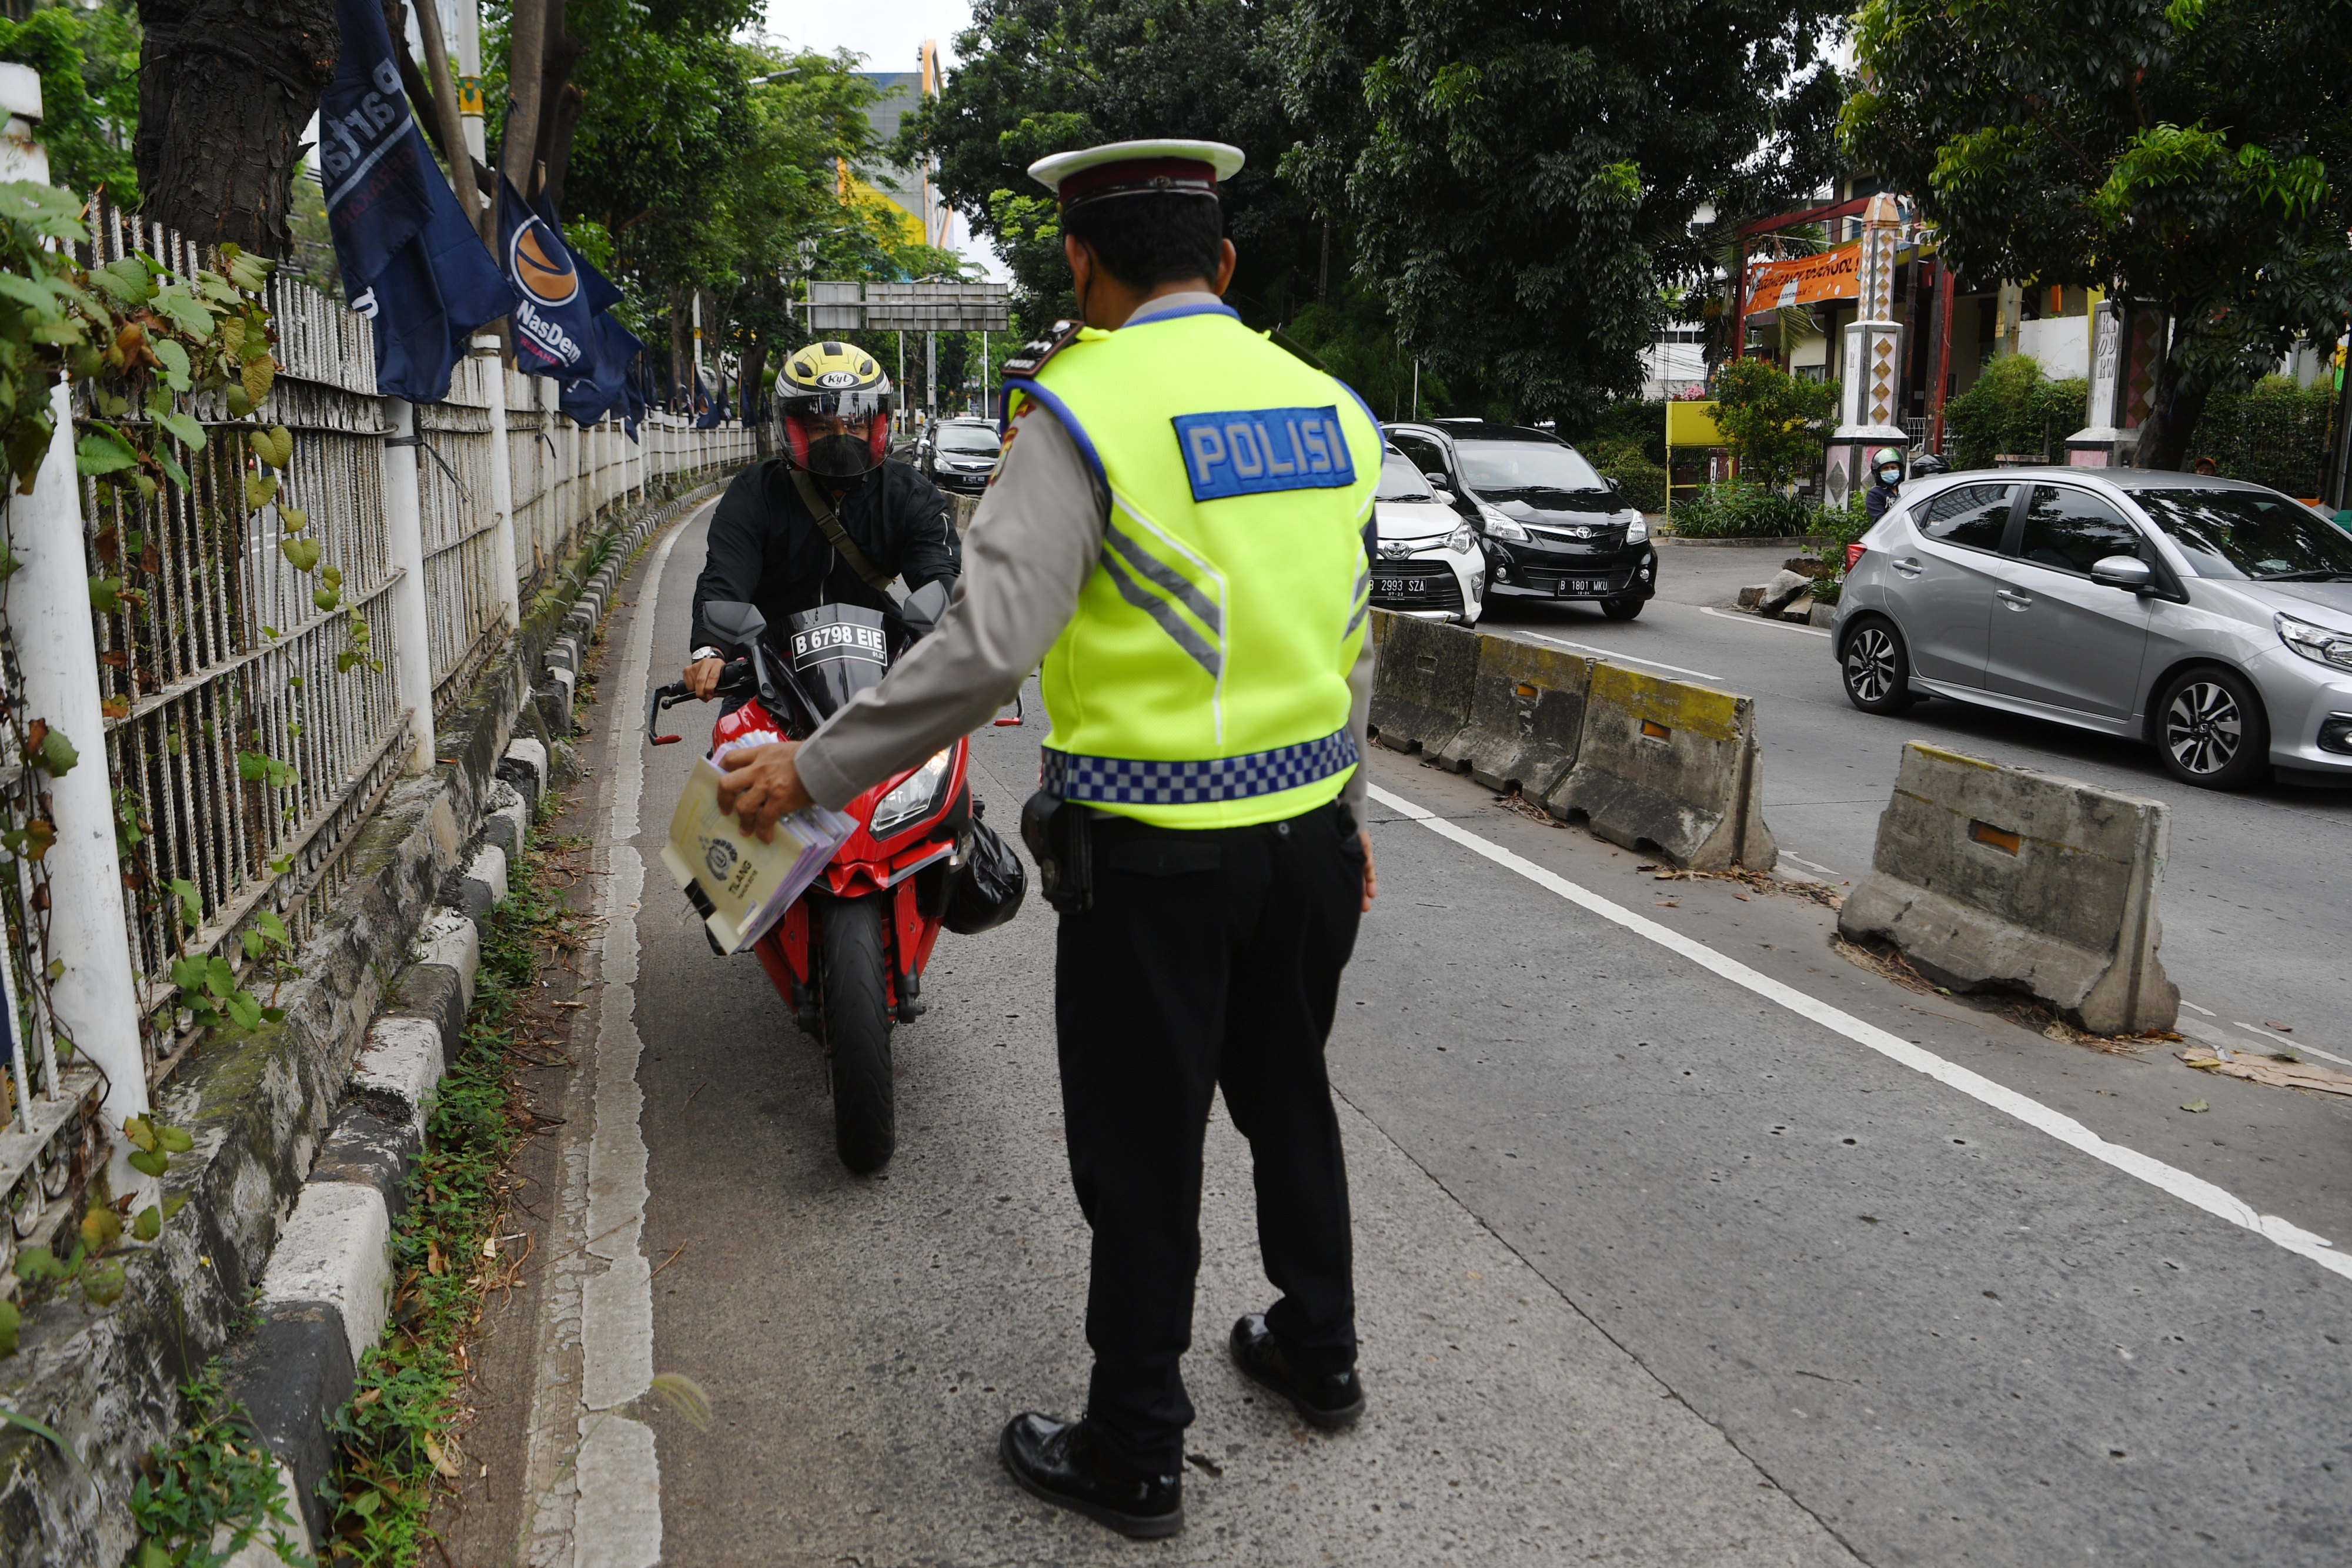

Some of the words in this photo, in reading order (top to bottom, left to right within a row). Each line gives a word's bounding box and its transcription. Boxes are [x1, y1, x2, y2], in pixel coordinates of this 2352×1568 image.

[516, 299, 582, 363] NasDem
[2097, 357, 2116, 379] RW
[1188, 419, 1347, 483] POLISI
[1369, 580, 1374, 591] B
[1381, 580, 1403, 591] 2993
[1408, 580, 1424, 591] SZA
[1561, 580, 1565, 590] B
[1572, 581, 1588, 590] 1801
[1593, 581, 1608, 591] WKU
[796, 636, 807, 654] B
[811, 626, 853, 648] 6798
[857, 628, 883, 650] EIE
[728, 860, 752, 894] TILANG
